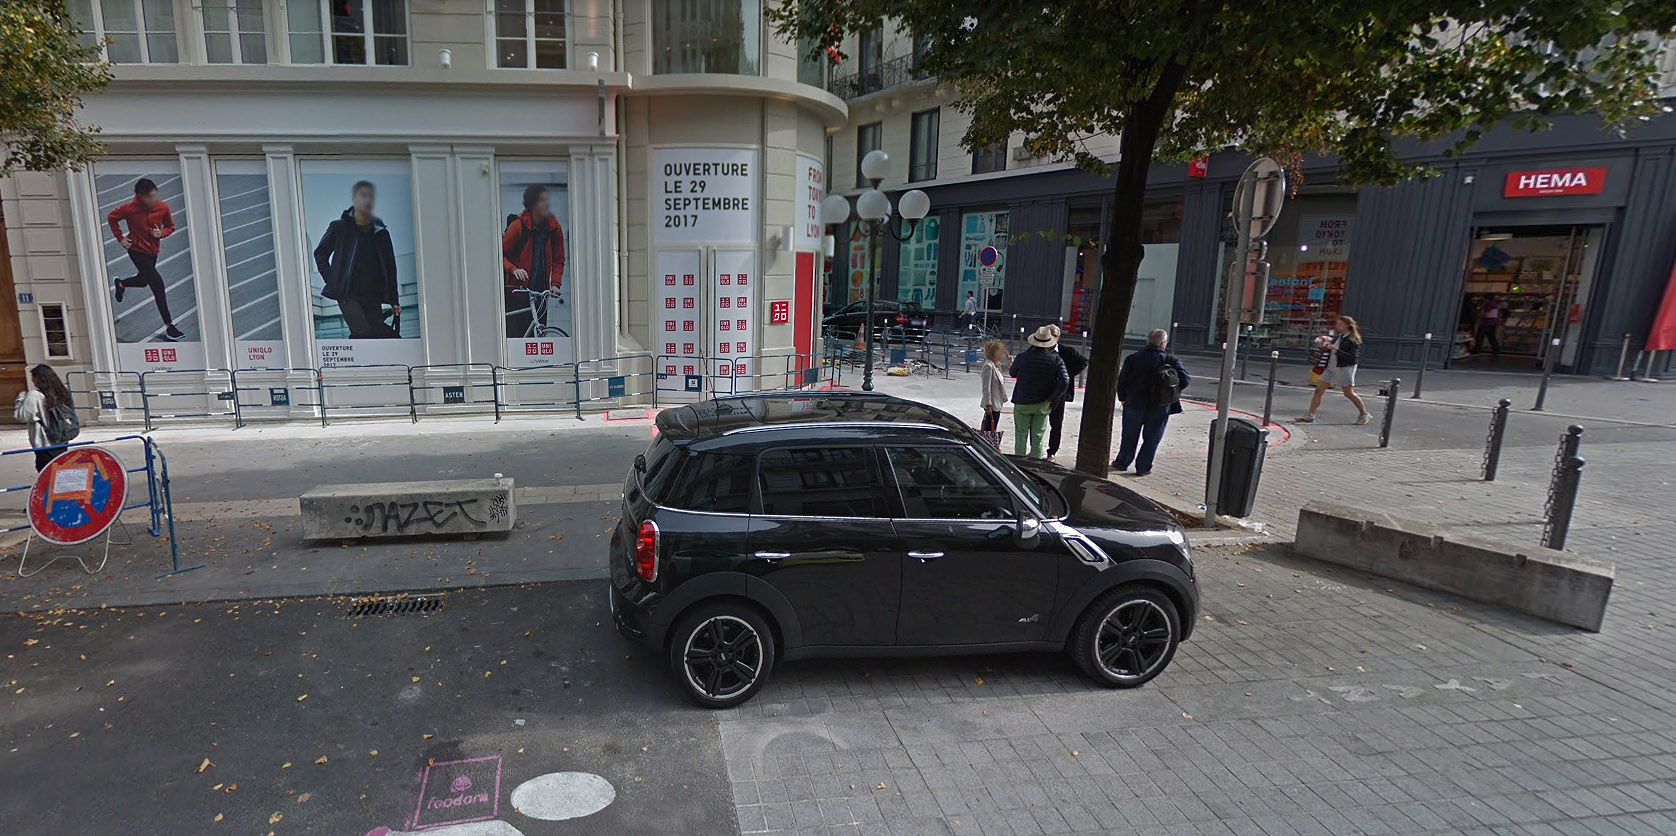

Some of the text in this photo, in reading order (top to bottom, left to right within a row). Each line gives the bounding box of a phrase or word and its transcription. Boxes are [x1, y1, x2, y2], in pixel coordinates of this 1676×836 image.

[664, 163, 748, 176] OUVERTURE
[664, 180, 706, 194] LE 29
[1518, 172, 1588, 189] HEMA
[664, 197, 749, 210] SEPTEMBRE
[808, 204, 816, 220] TO
[665, 215, 698, 228] 2017
